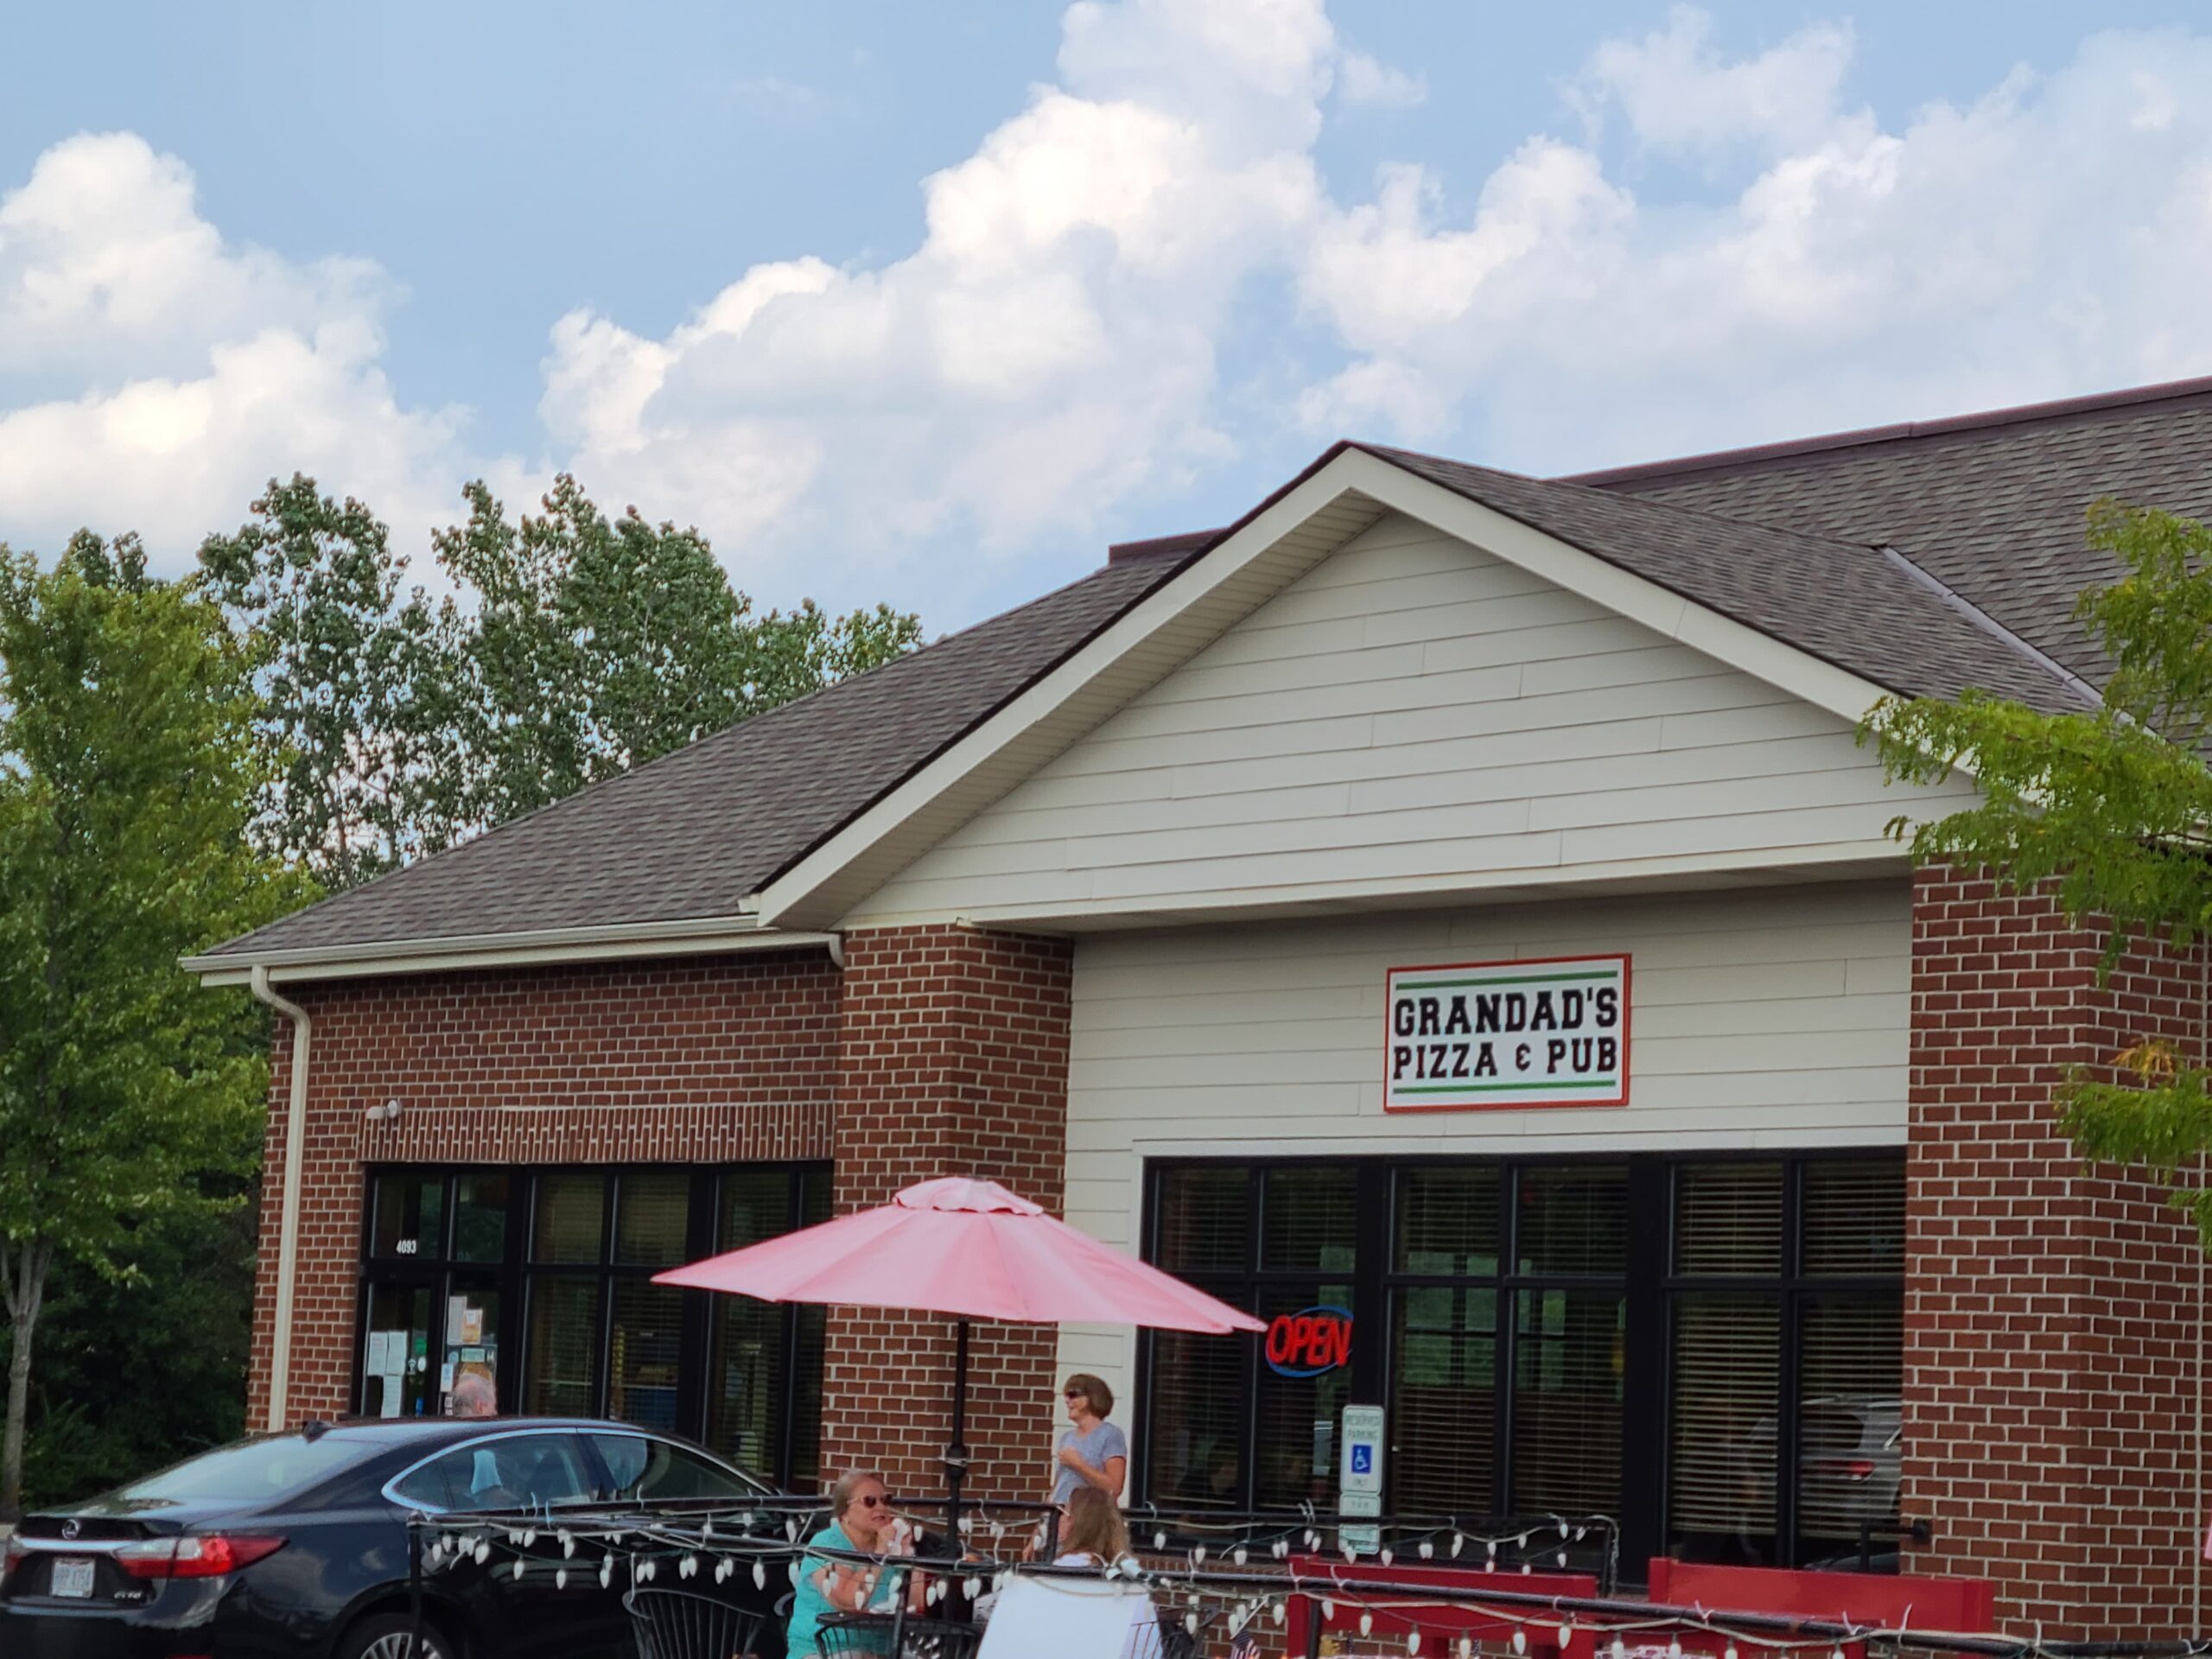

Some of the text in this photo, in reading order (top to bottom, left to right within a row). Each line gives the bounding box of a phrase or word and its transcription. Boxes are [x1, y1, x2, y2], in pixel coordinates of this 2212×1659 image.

[1395, 987, 1618, 1037] GRANDAD'S
[1393, 1037, 1618, 1079] PIZZA & PUB
[396, 1239, 416, 1254] 4093
[1268, 1314, 1353, 1366] OPEN
